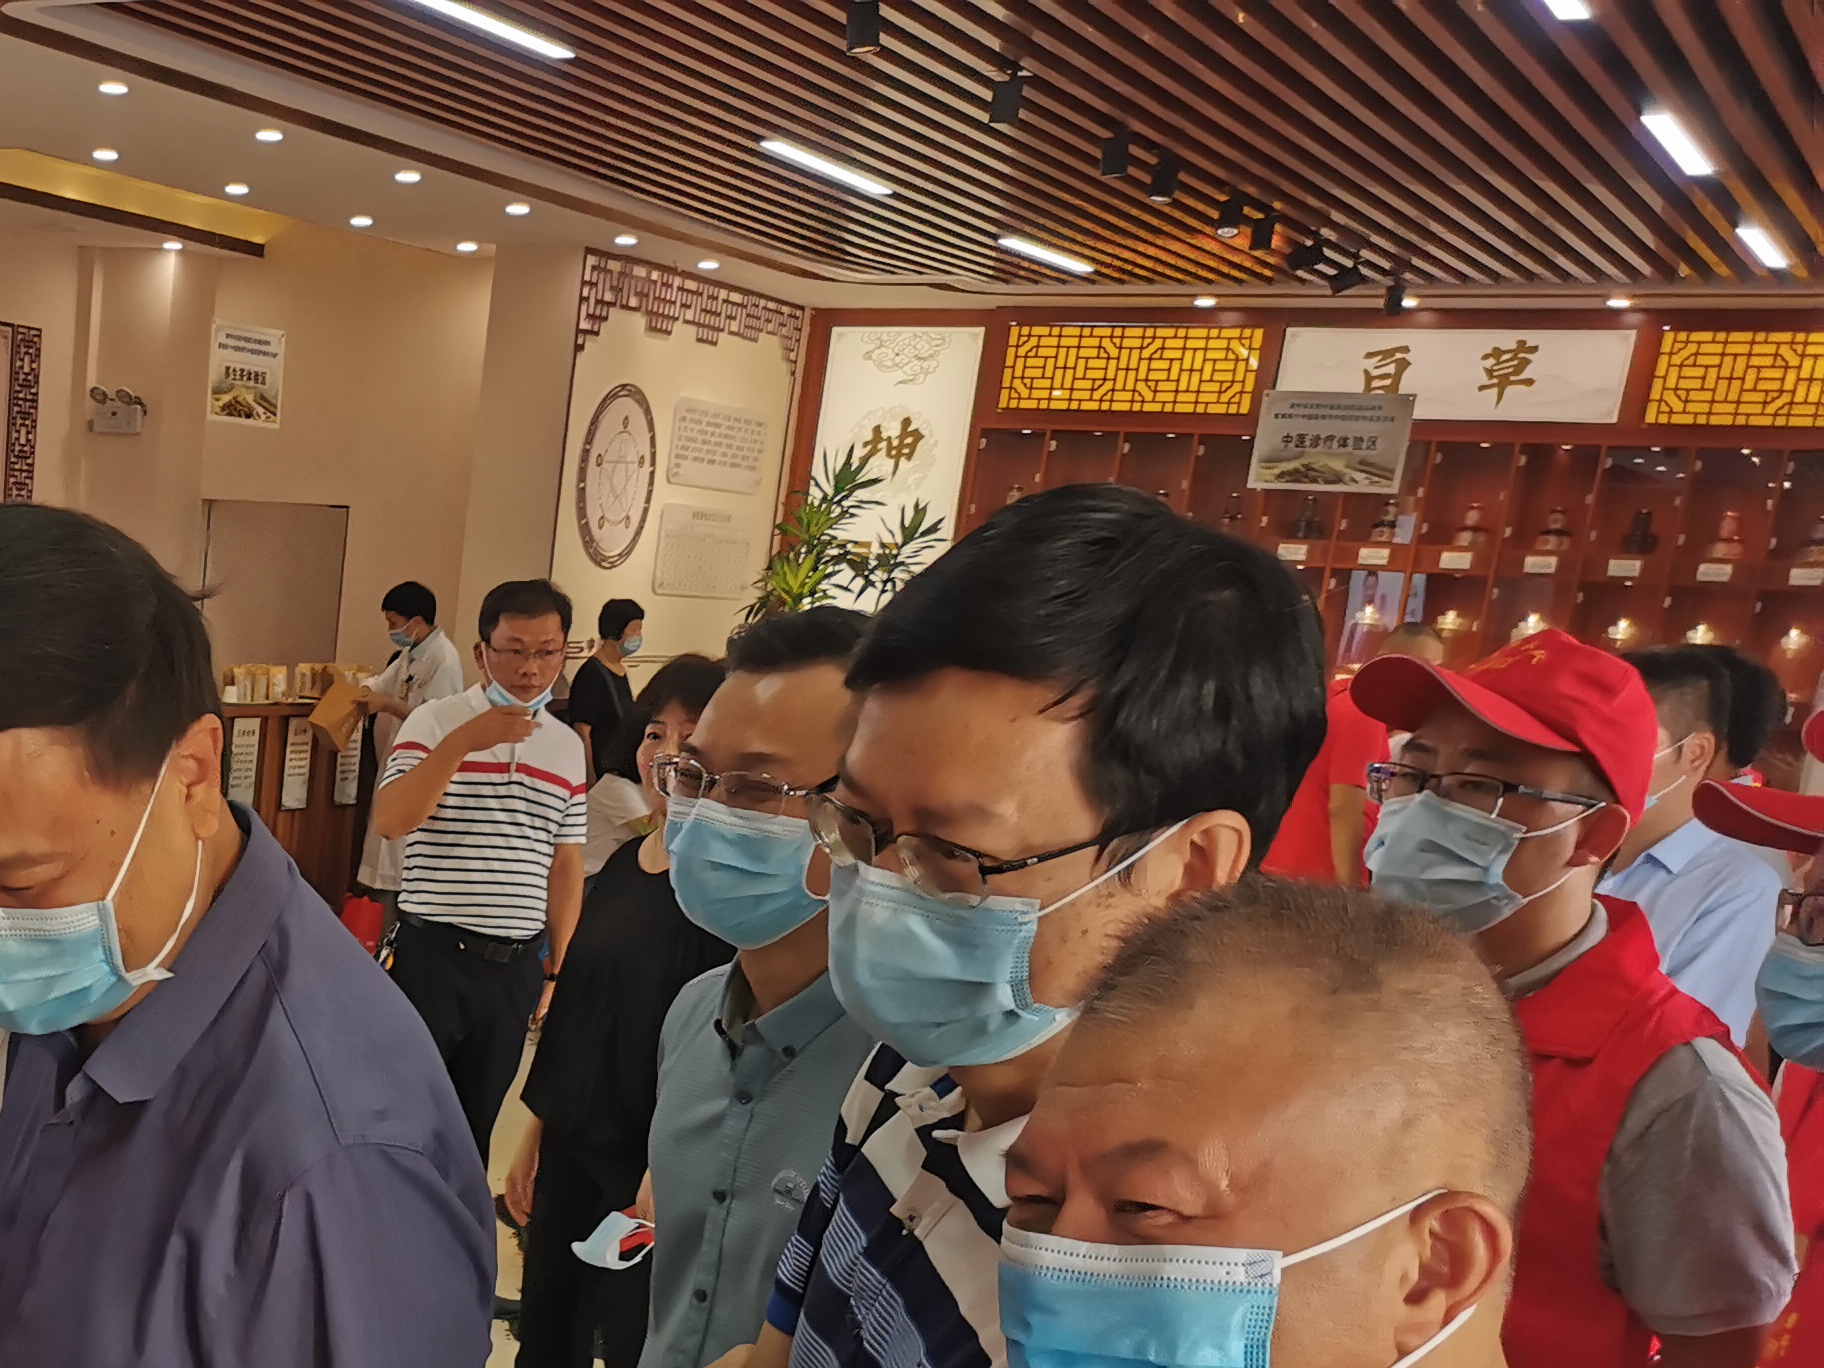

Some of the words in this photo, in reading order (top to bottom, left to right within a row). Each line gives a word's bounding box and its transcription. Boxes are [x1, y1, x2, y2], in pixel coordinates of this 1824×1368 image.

[859, 416, 926, 481] 坤
[1281, 432, 1379, 451] 中医诊疗体验区
